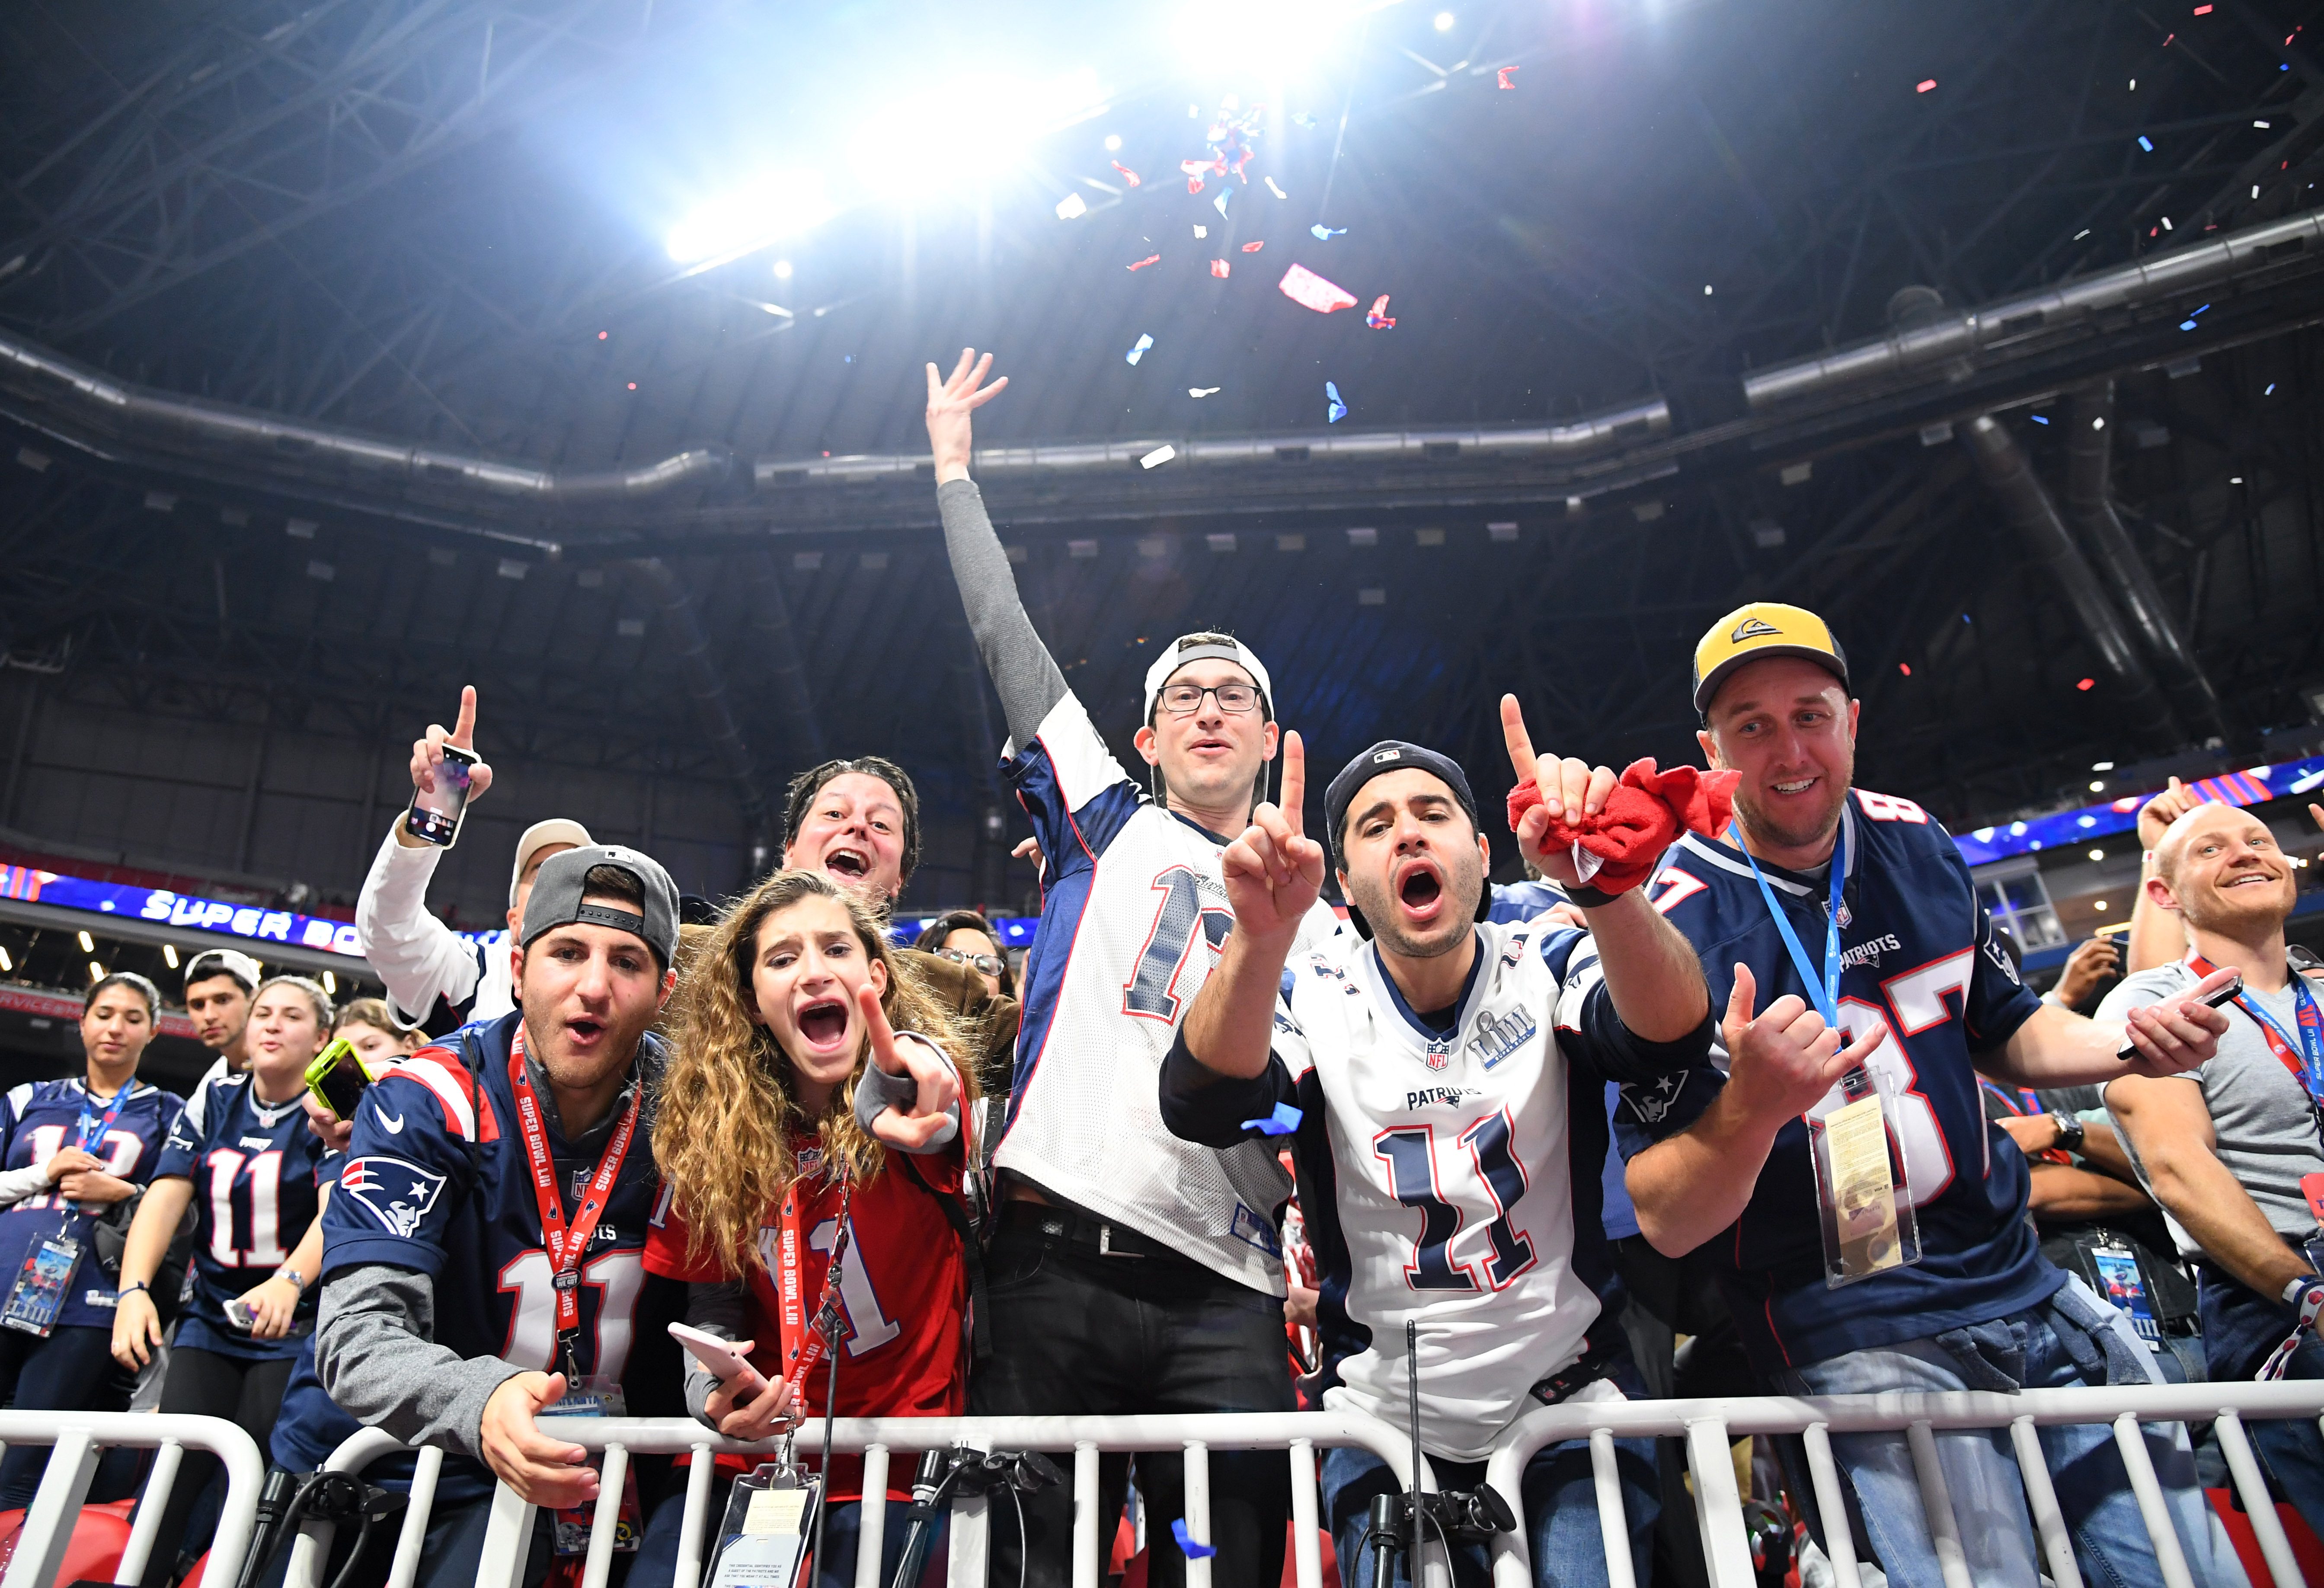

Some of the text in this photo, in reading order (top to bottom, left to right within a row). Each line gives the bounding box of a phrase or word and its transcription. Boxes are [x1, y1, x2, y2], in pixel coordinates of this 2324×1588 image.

[140, 889, 368, 957] SUPER BO
[1122, 864, 1235, 1026] 1
[1839, 933, 1901, 974] PATRIOTS
[1470, 1003, 1536, 1064] LIII
[1494, 1032, 1531, 1061] SUPER BOWL
[2255, 1011, 2279, 1030] SUPER
[2309, 1038, 2319, 1056] BOWL
[1428, 1054, 1447, 1068] NFL
[1802, 945, 1975, 1211] 87
[2313, 1056, 2322, 1080] SUPER
[519, 1096, 551, 1187] SUPER BOWL LIII
[595, 1155, 619, 1192] SUPER
[611, 1125, 630, 1156] BOWL
[801, 1159, 820, 1173] NFL
[208, 1147, 288, 1268] 11
[1372, 1103, 1538, 1292] 11
[550, 1230, 564, 1263] SUP
[562, 1288, 574, 1317] SUPE
[568, 1231, 585, 1252] LIII
[783, 1229, 799, 1325] SUPER BOWL LIII
[497, 1248, 647, 1384] 11
[791, 1364, 809, 1396] BOWL
[803, 1343, 821, 1362] LIII
